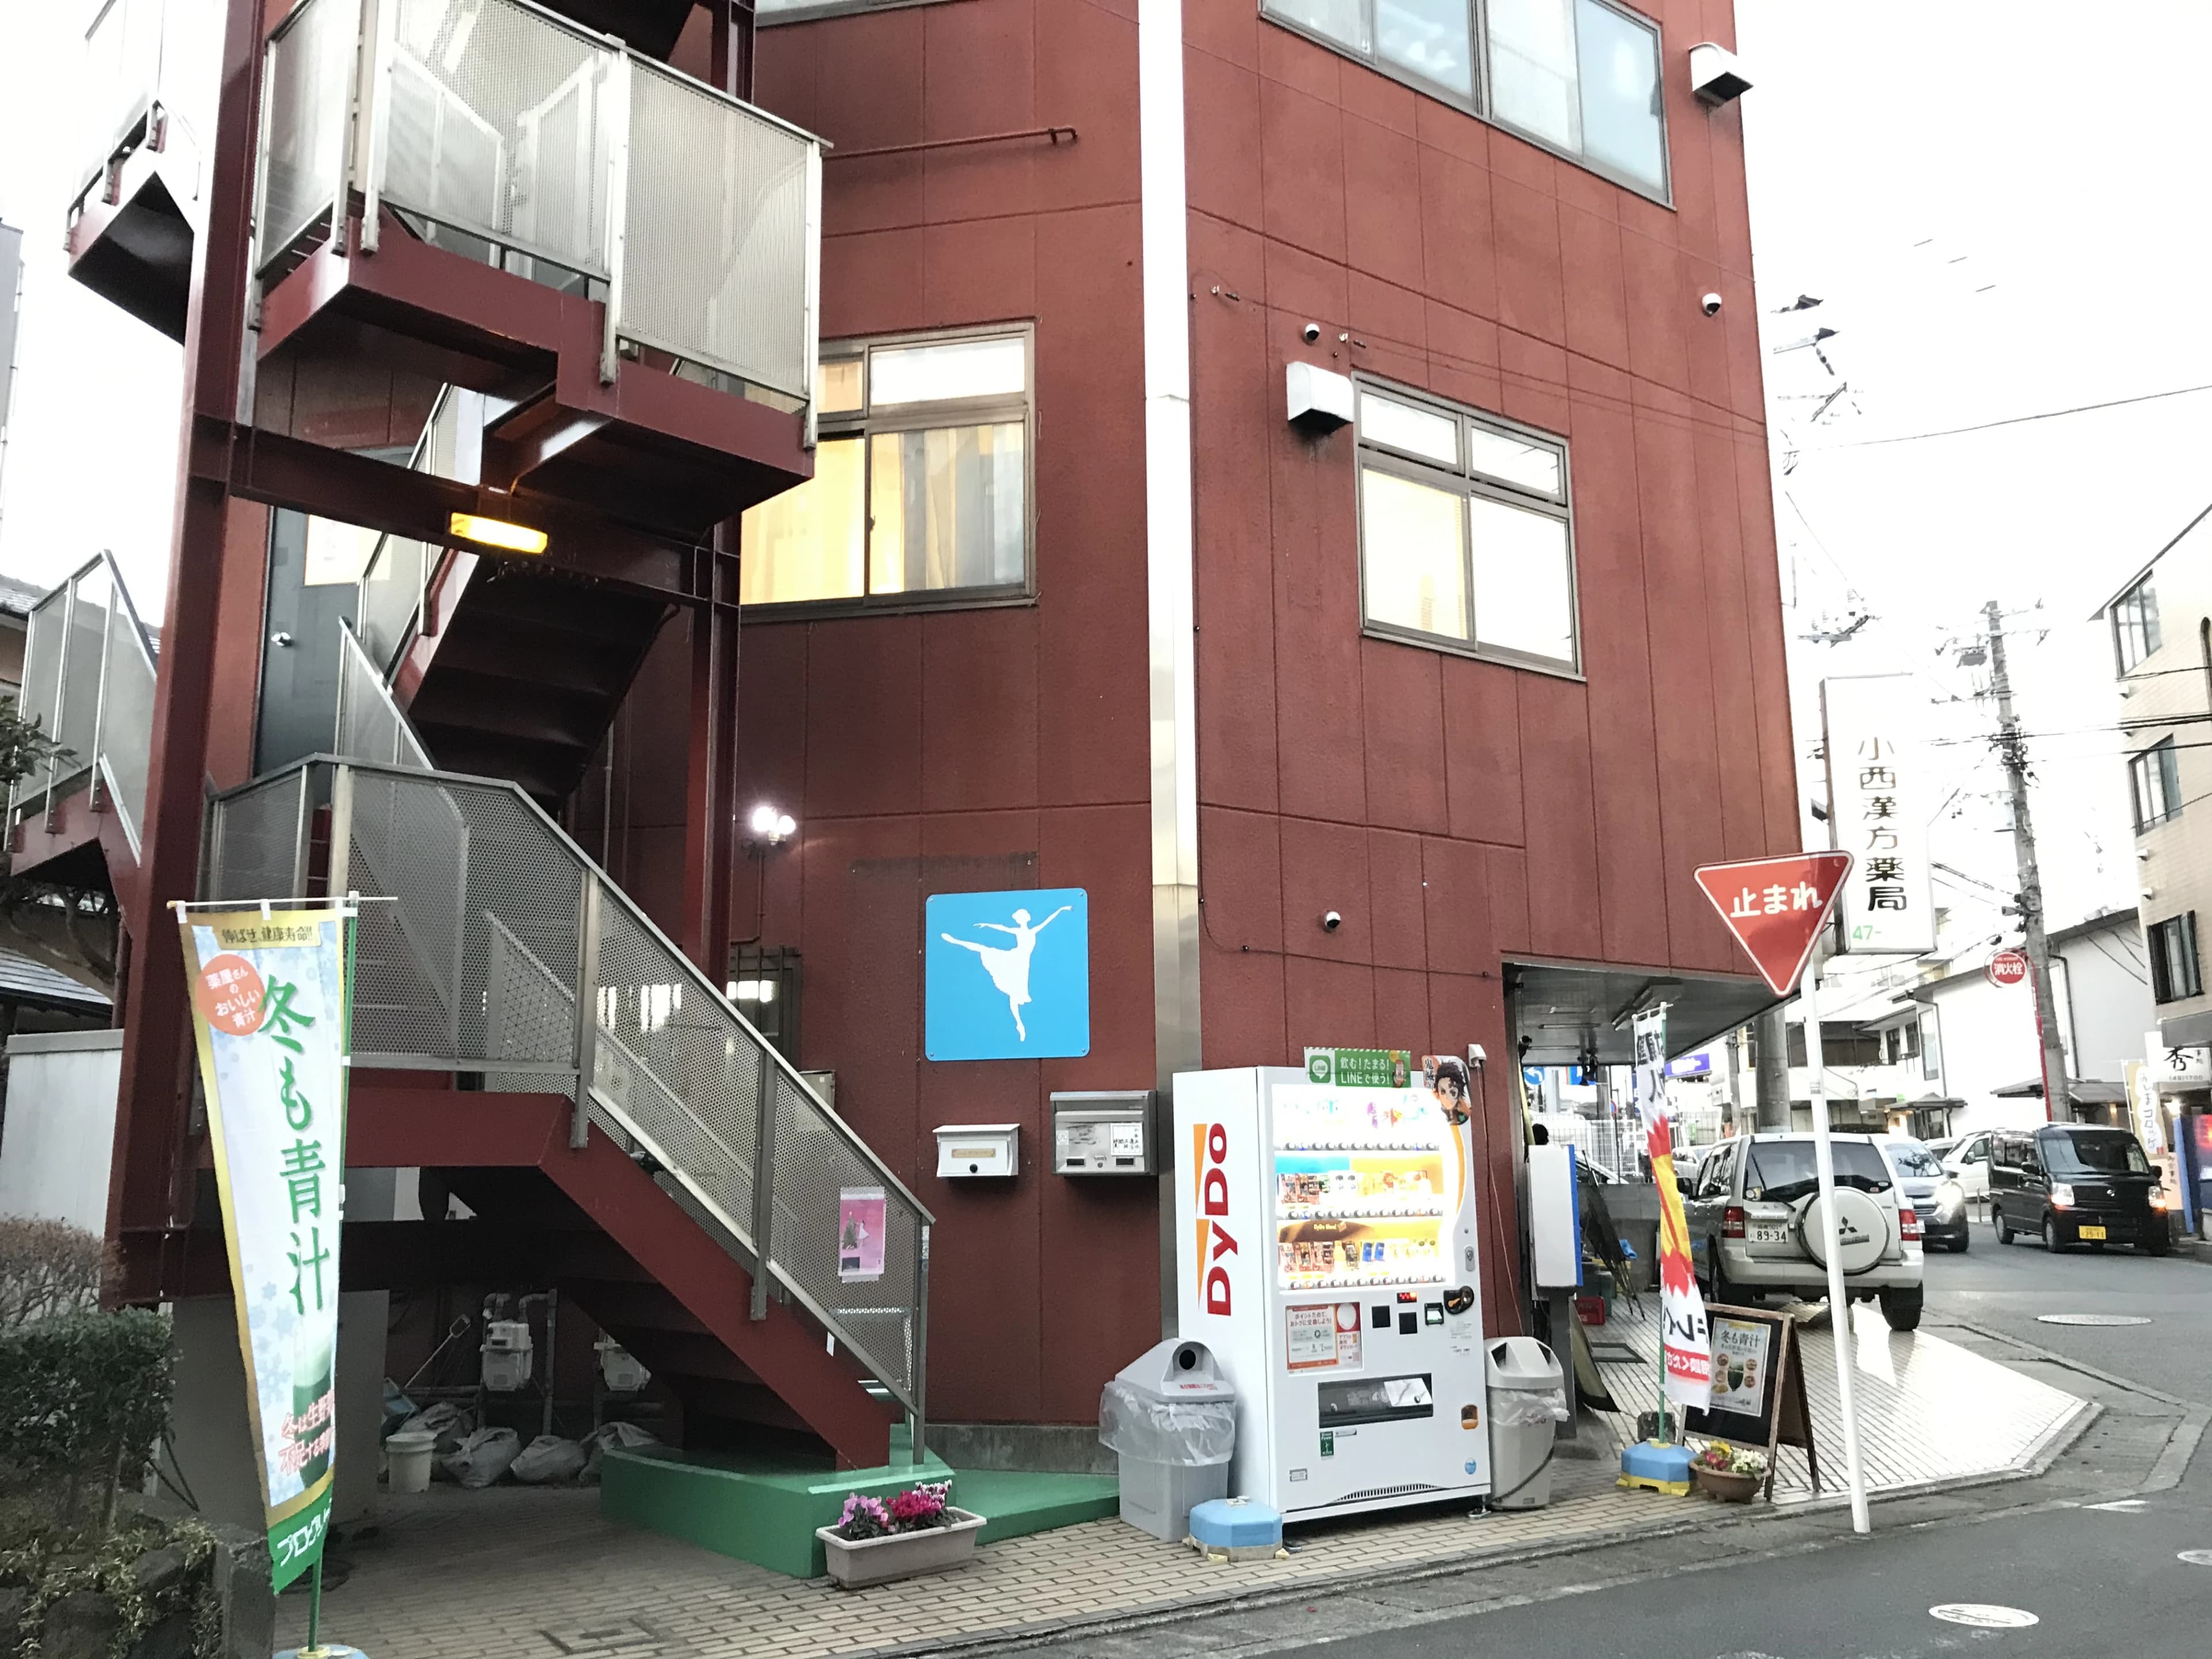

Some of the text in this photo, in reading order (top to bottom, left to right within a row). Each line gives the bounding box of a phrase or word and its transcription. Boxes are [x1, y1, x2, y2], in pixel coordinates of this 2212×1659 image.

[1858, 736, 1907, 911] 小西漢方薬局
[1730, 881, 1822, 918] 止まれ
[1994, 961, 2024, 976] 消火栓
[215, 989, 260, 1017] おいしい
[257, 974, 330, 1316] 冬も青汁
